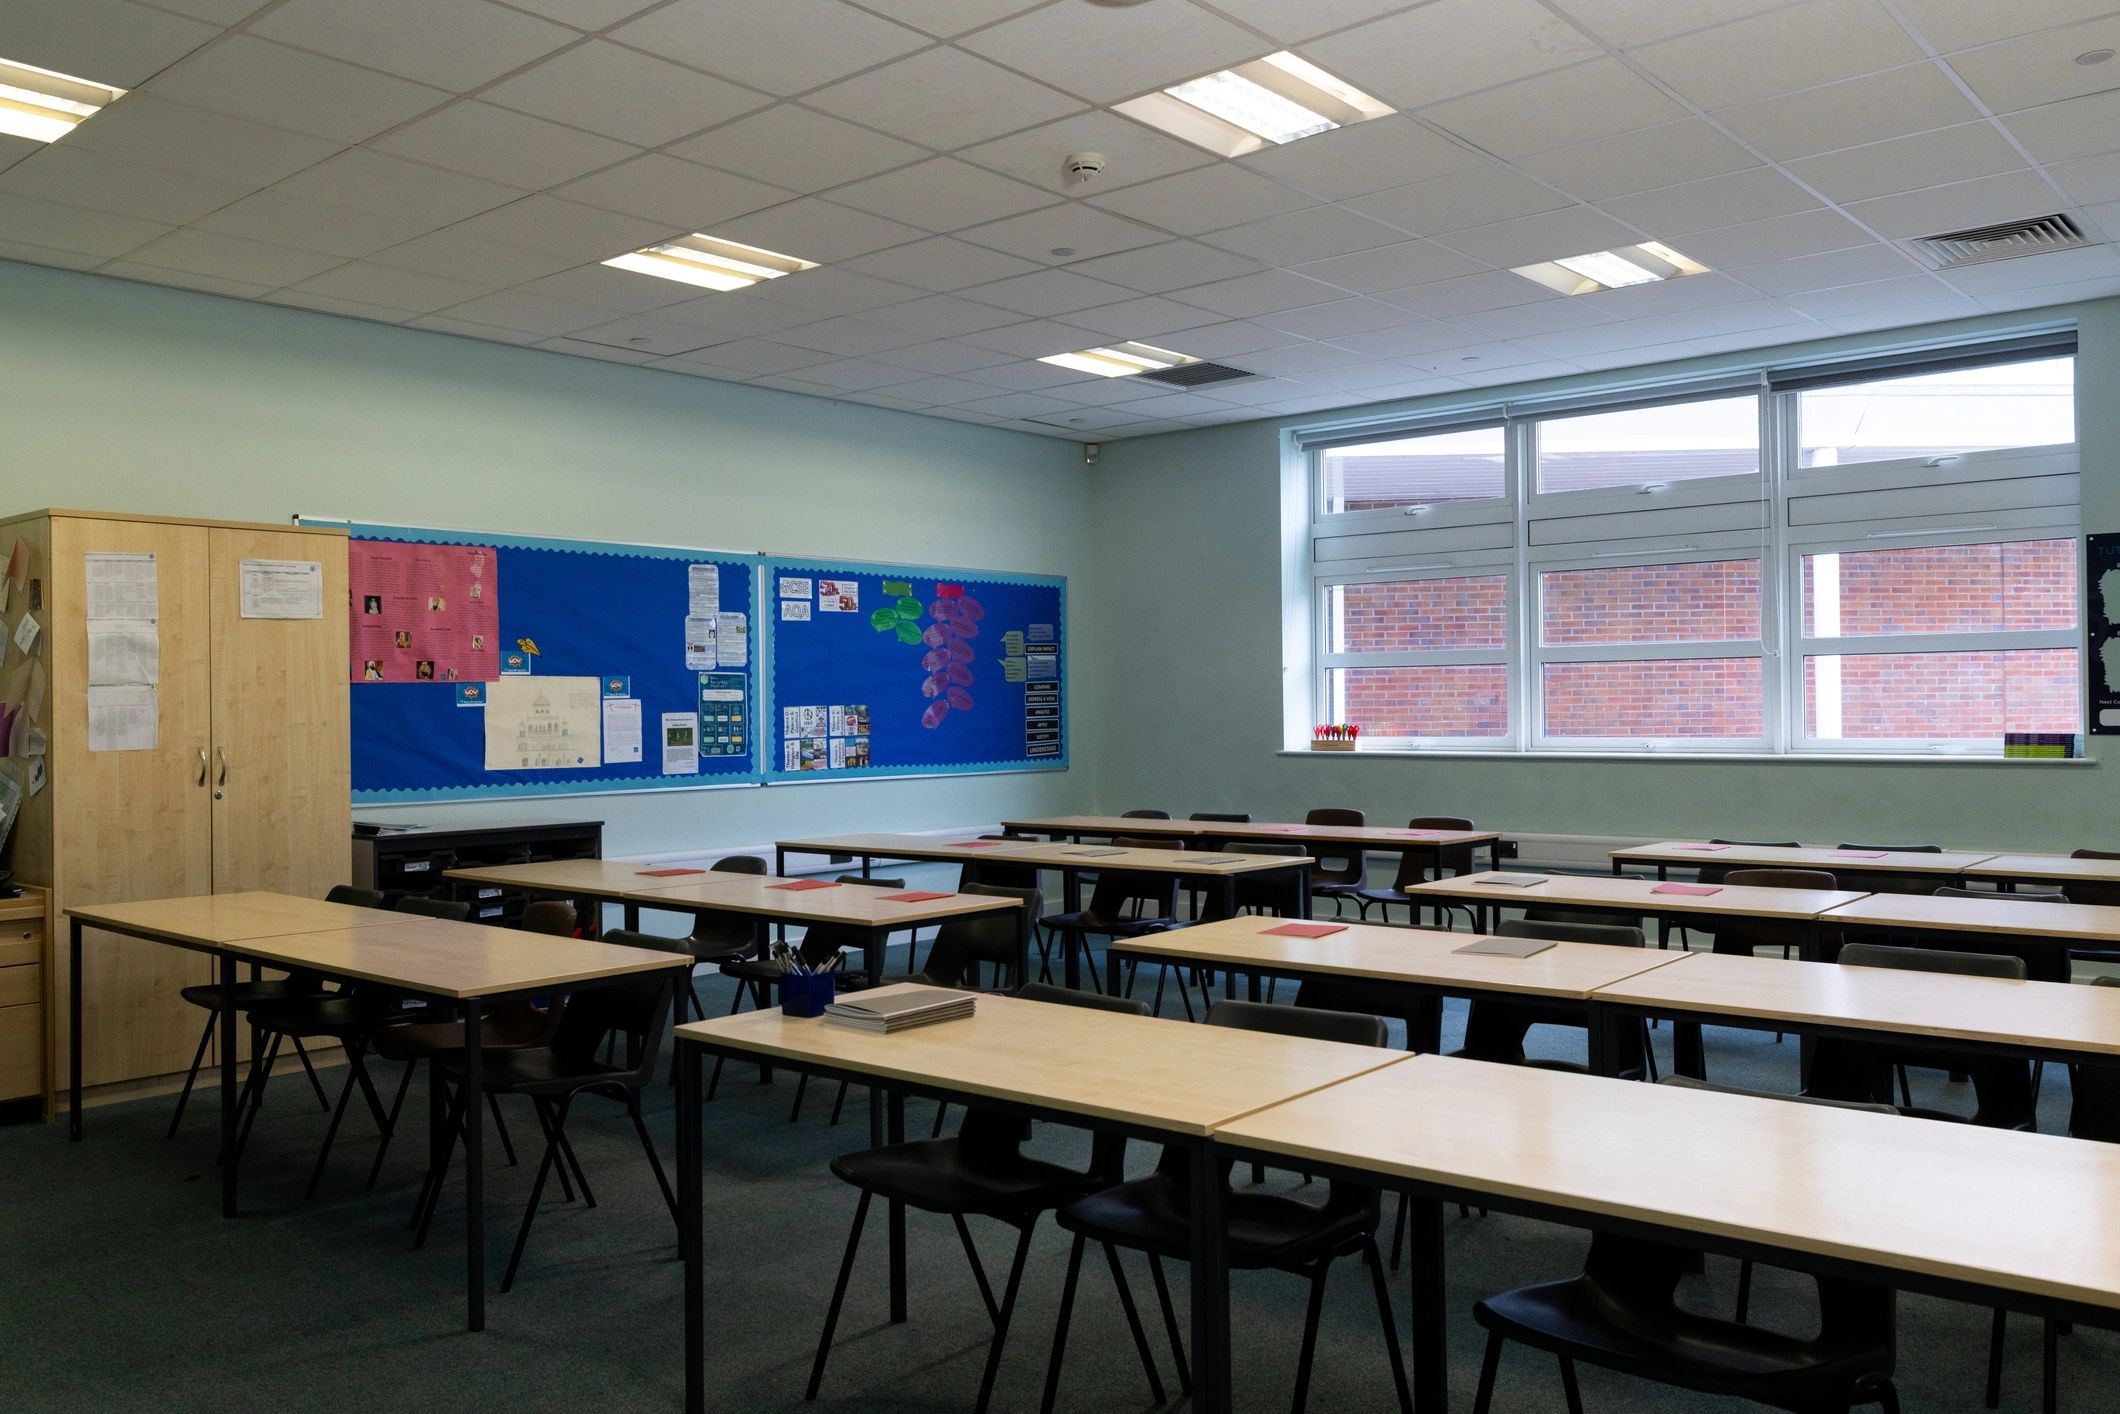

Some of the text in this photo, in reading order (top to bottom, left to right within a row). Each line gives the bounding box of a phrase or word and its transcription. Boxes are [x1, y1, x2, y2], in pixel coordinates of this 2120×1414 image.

[781, 580, 809, 594] GCSE
[784, 604, 809, 619] AQA
[1029, 745, 1057, 753] UNDERSTAND
